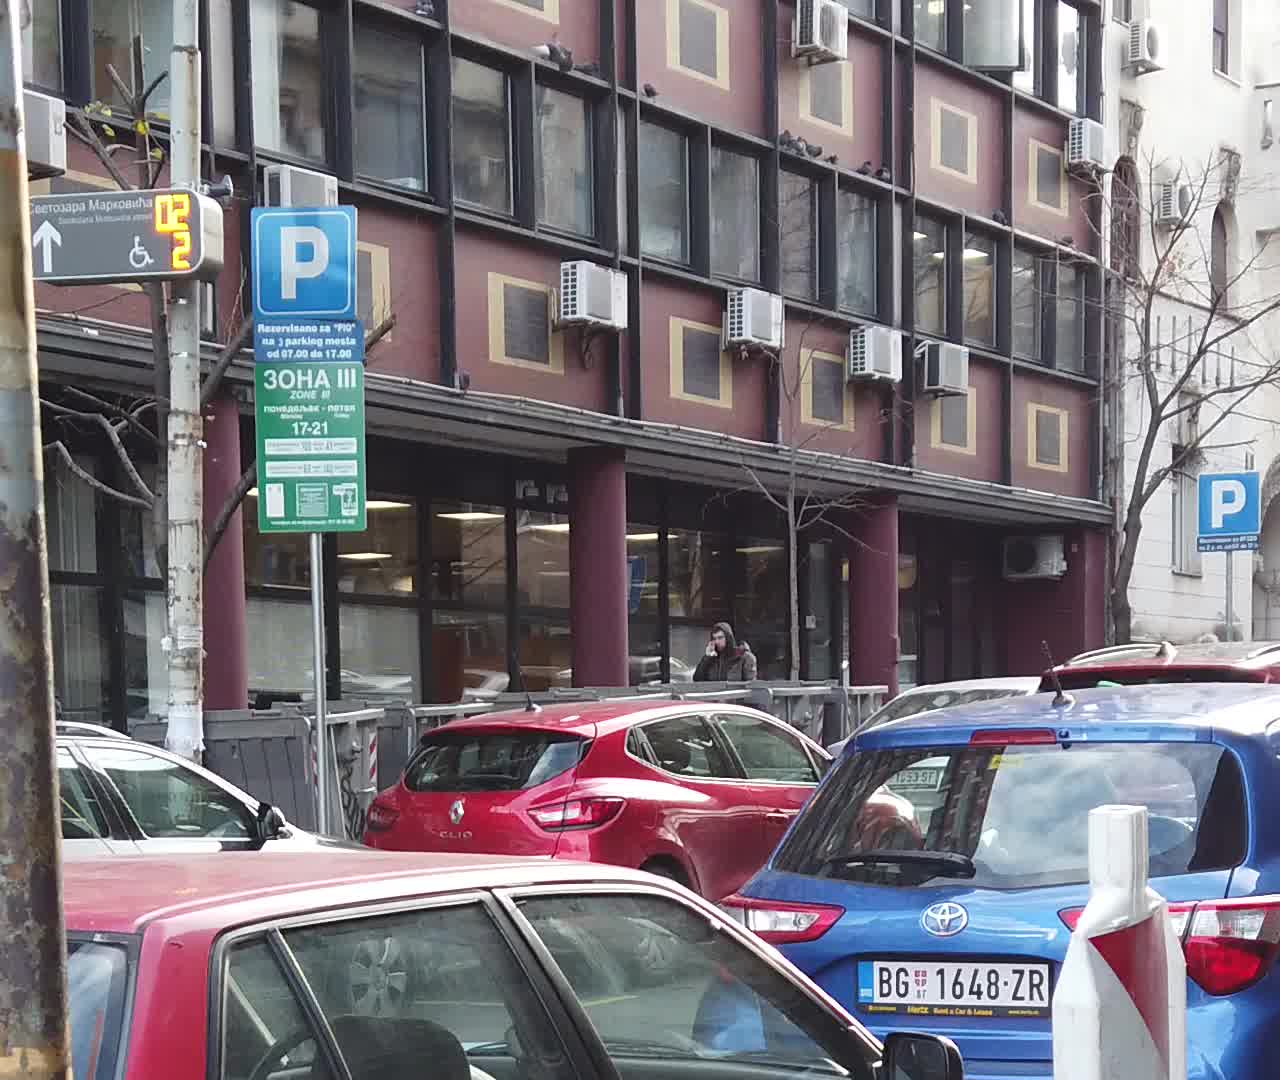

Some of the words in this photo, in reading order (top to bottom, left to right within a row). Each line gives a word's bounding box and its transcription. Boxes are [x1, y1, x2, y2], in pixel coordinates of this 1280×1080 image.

[172, 232, 191, 269] 2
[280, 226, 329, 300] P
[263, 369, 331, 390] ЗОНА
[289, 390, 317, 400] ZONE
[291, 421, 329, 436] 17-21
[1211, 479, 1247, 529] P
[878, 966, 910, 1000] BG
